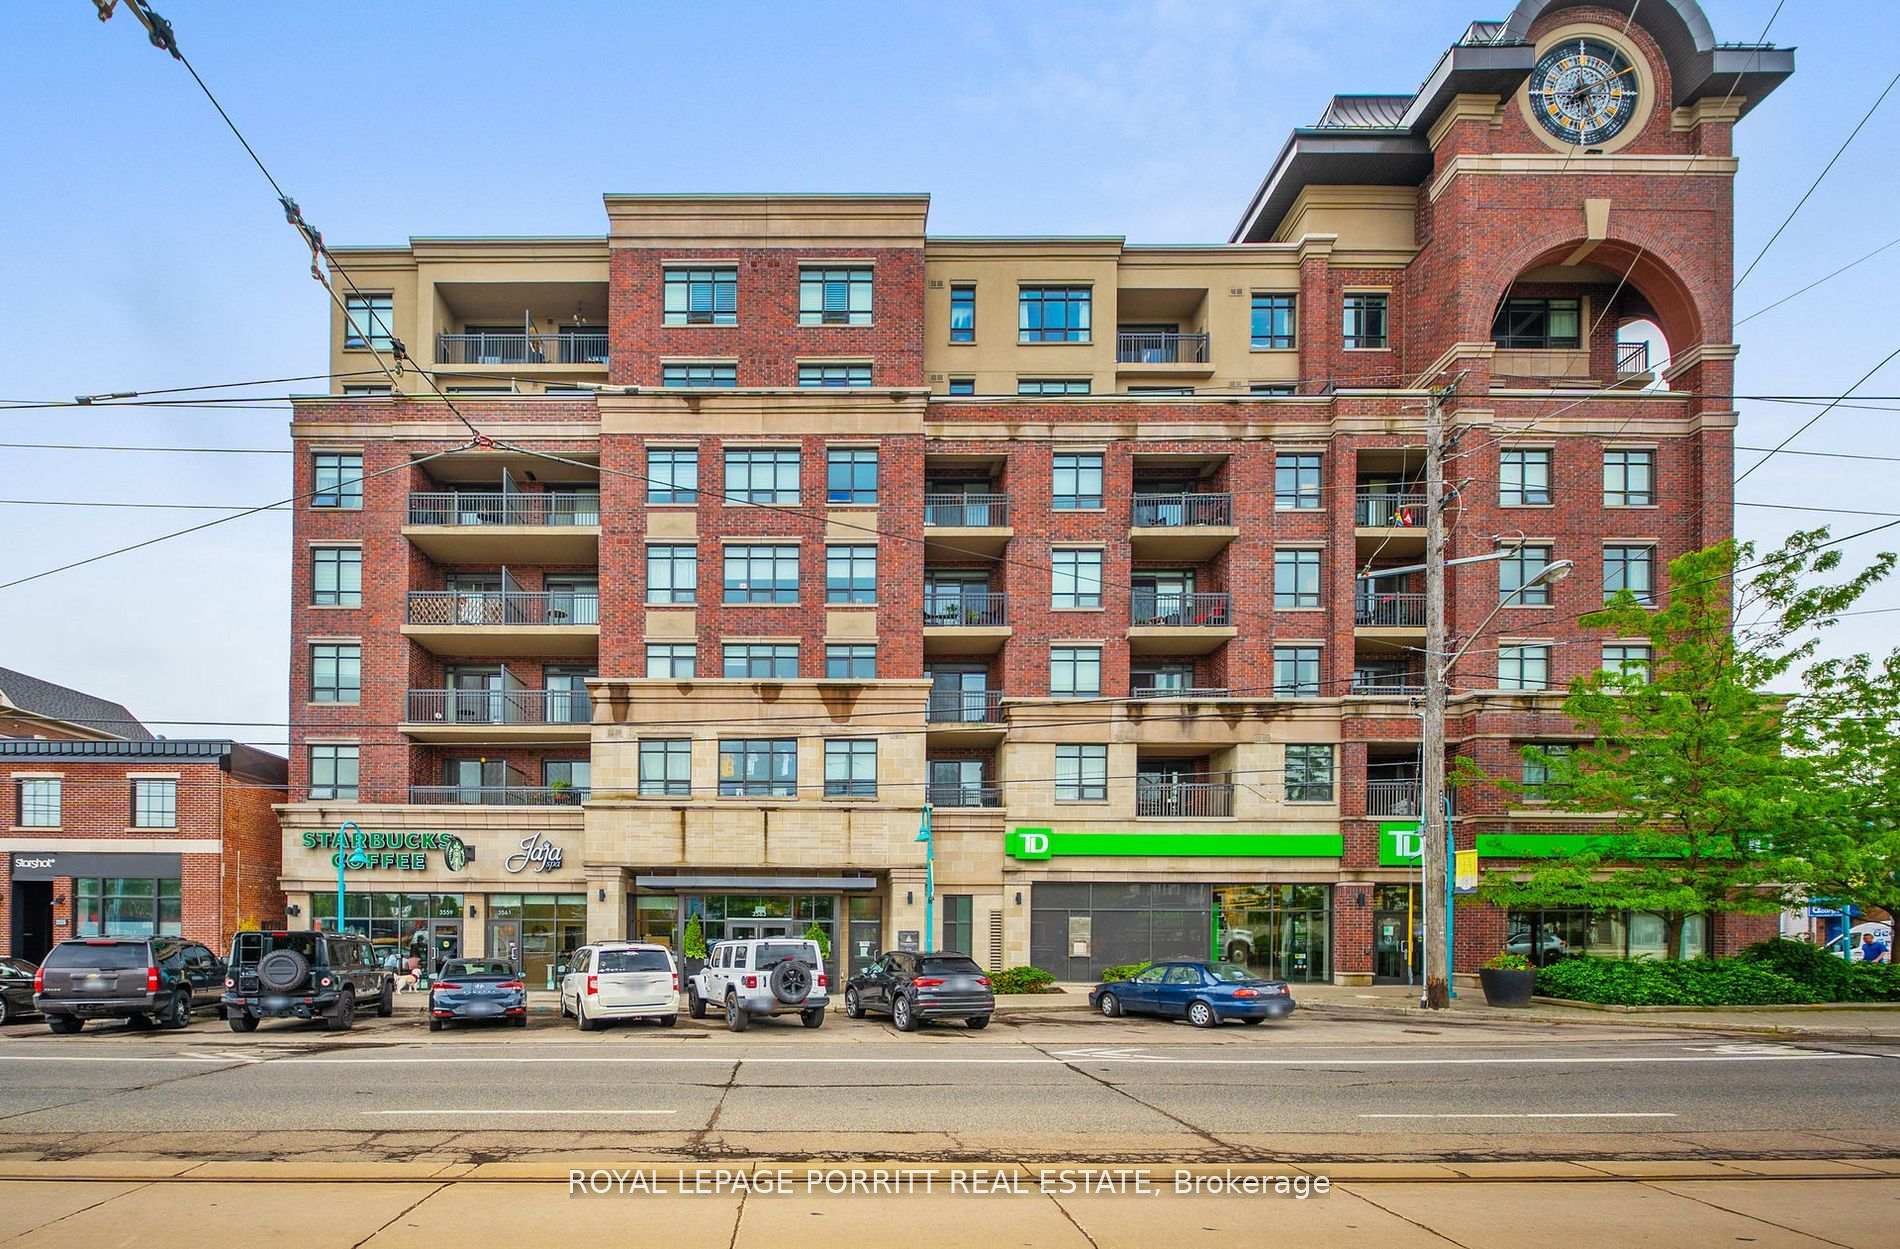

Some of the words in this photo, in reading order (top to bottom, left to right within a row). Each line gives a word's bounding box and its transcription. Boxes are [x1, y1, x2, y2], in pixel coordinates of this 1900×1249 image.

[303, 832, 451, 849] STARBUCKS
[505, 831, 563, 872] Jaja
[1019, 833, 1049, 853] TD
[1388, 831, 1425, 857] TD
